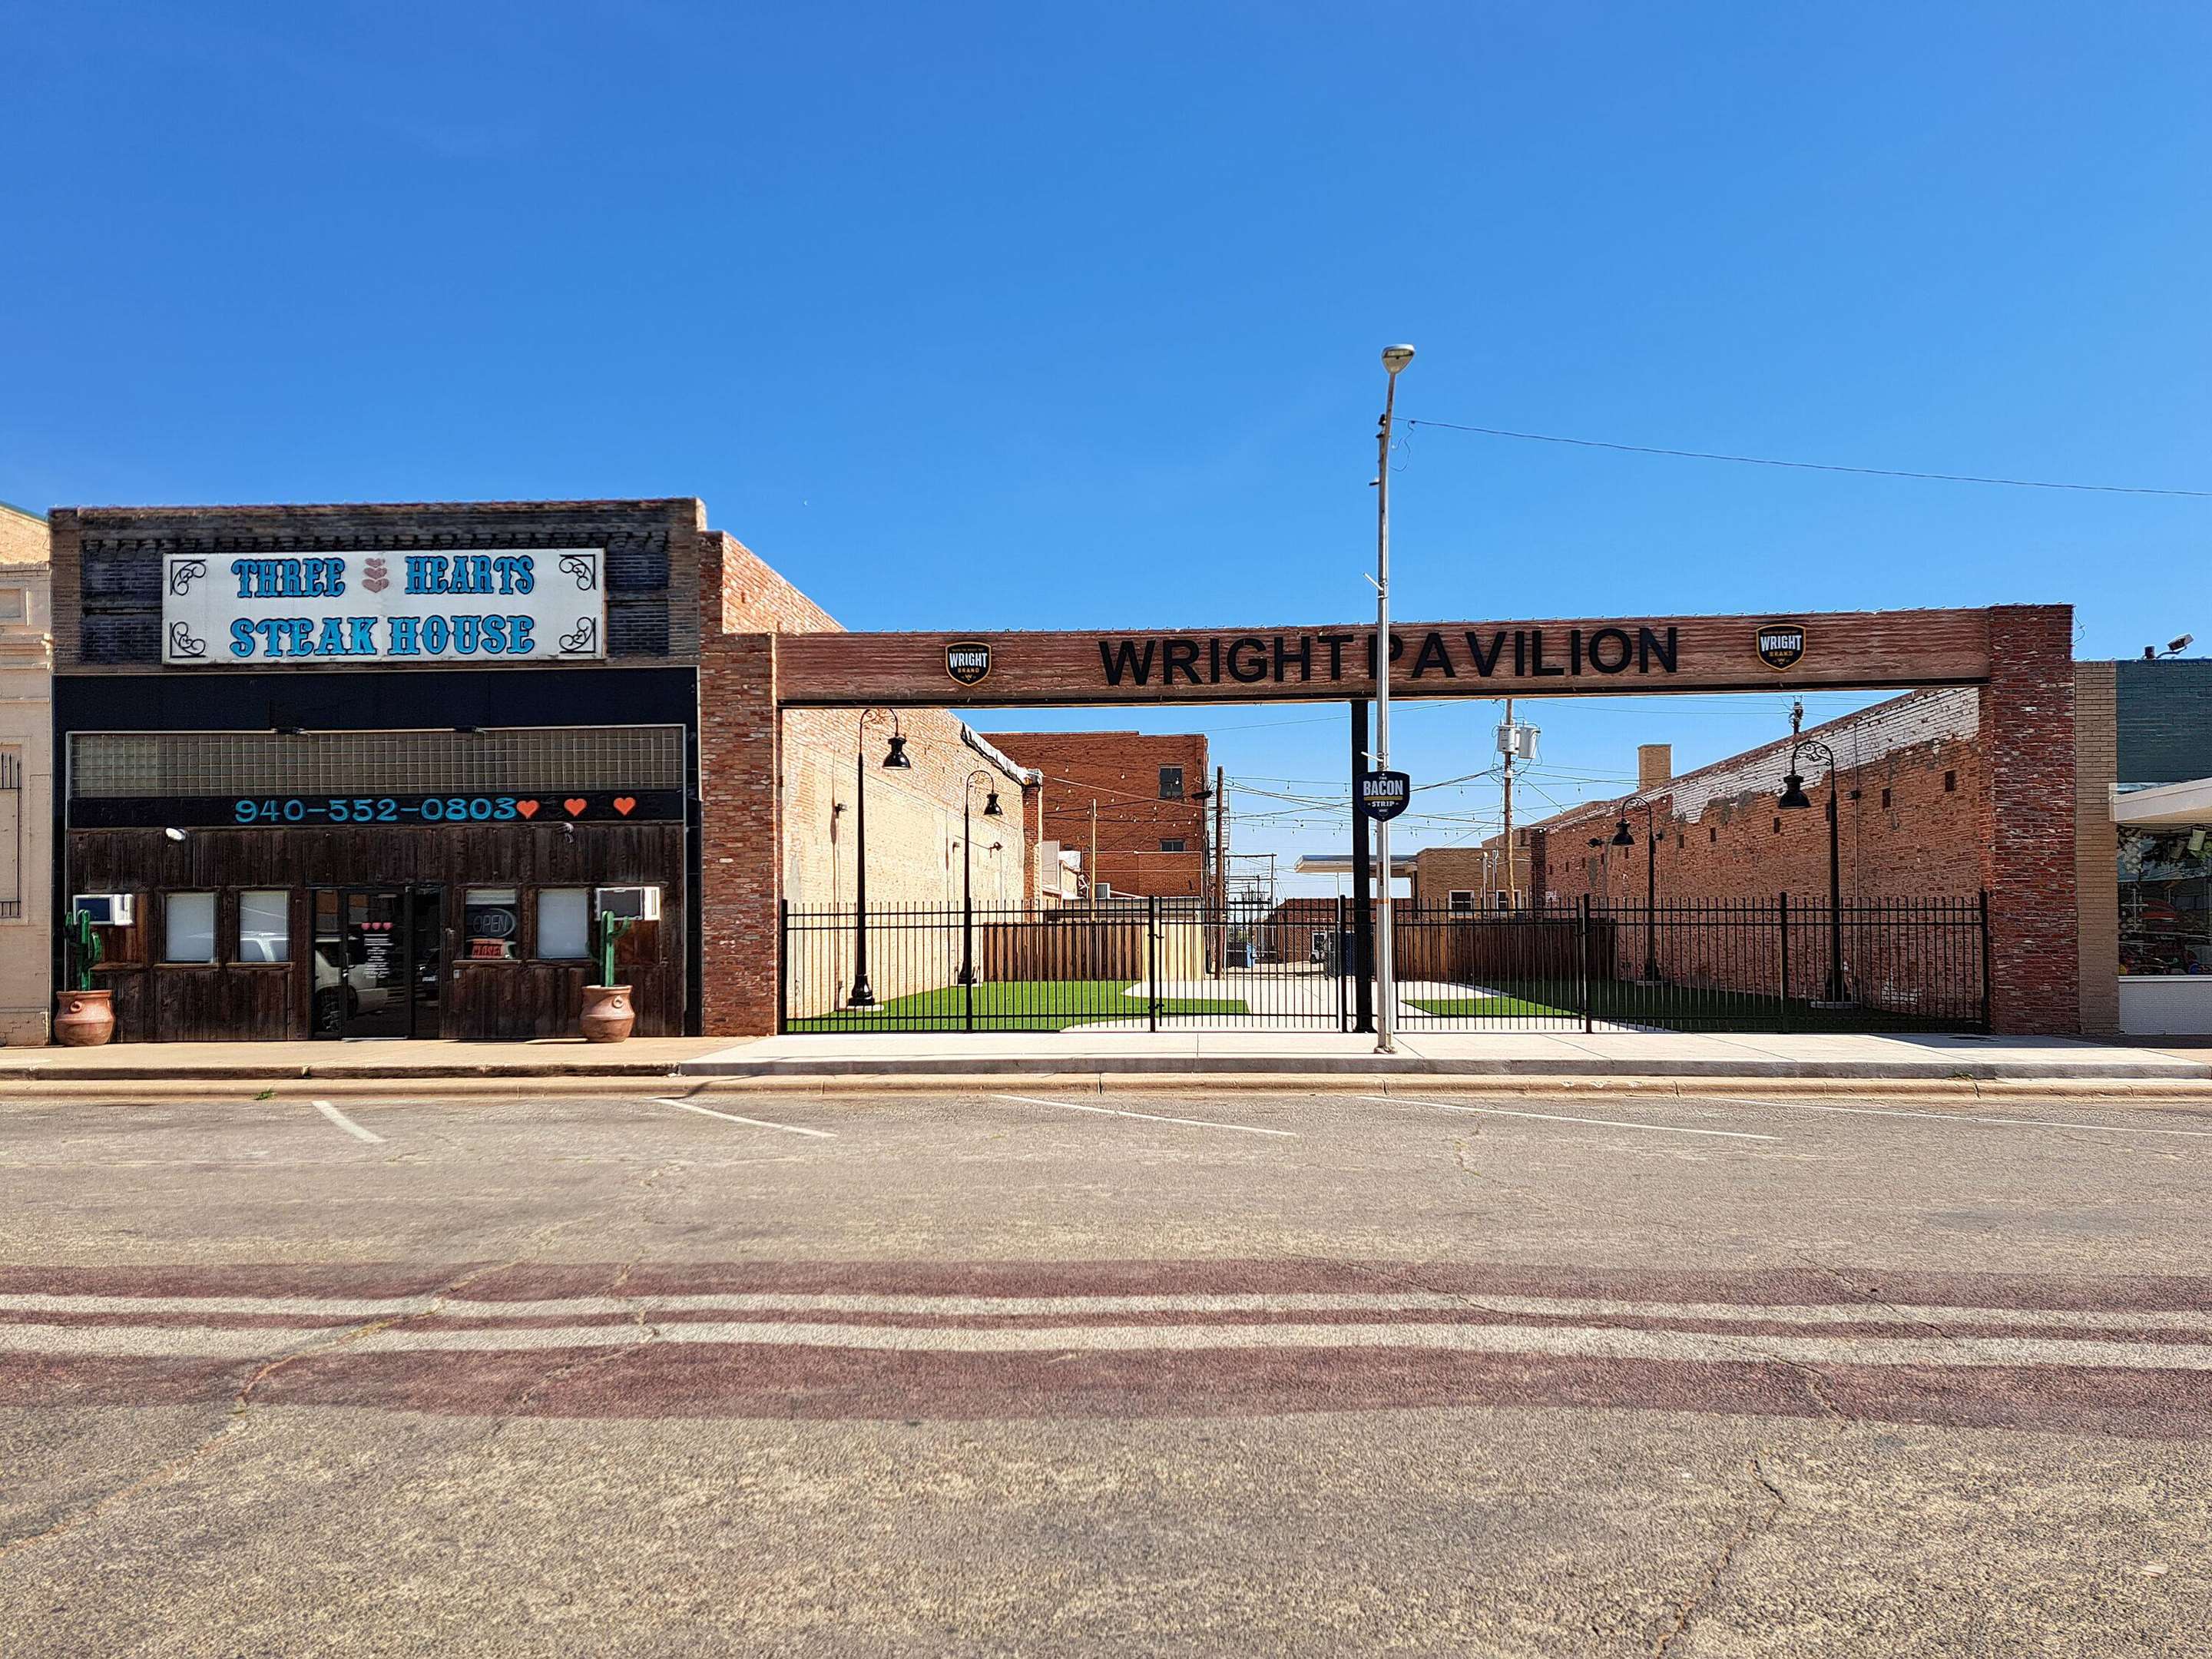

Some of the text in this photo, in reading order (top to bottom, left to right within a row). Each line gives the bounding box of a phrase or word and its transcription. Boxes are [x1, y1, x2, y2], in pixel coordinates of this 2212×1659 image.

[231, 555, 535, 598] THREE HEARTS
[230, 614, 535, 657] STEAK HOUSE
[1760, 634, 1802, 652] WRIGHT
[949, 652, 988, 668] WRIGHT
[1098, 627, 1678, 686] WRIGHT PAVILION
[1363, 780, 1403, 796] BACON
[234, 798, 517, 823] 940-552-0803
[473, 914, 508, 933] OPEN
